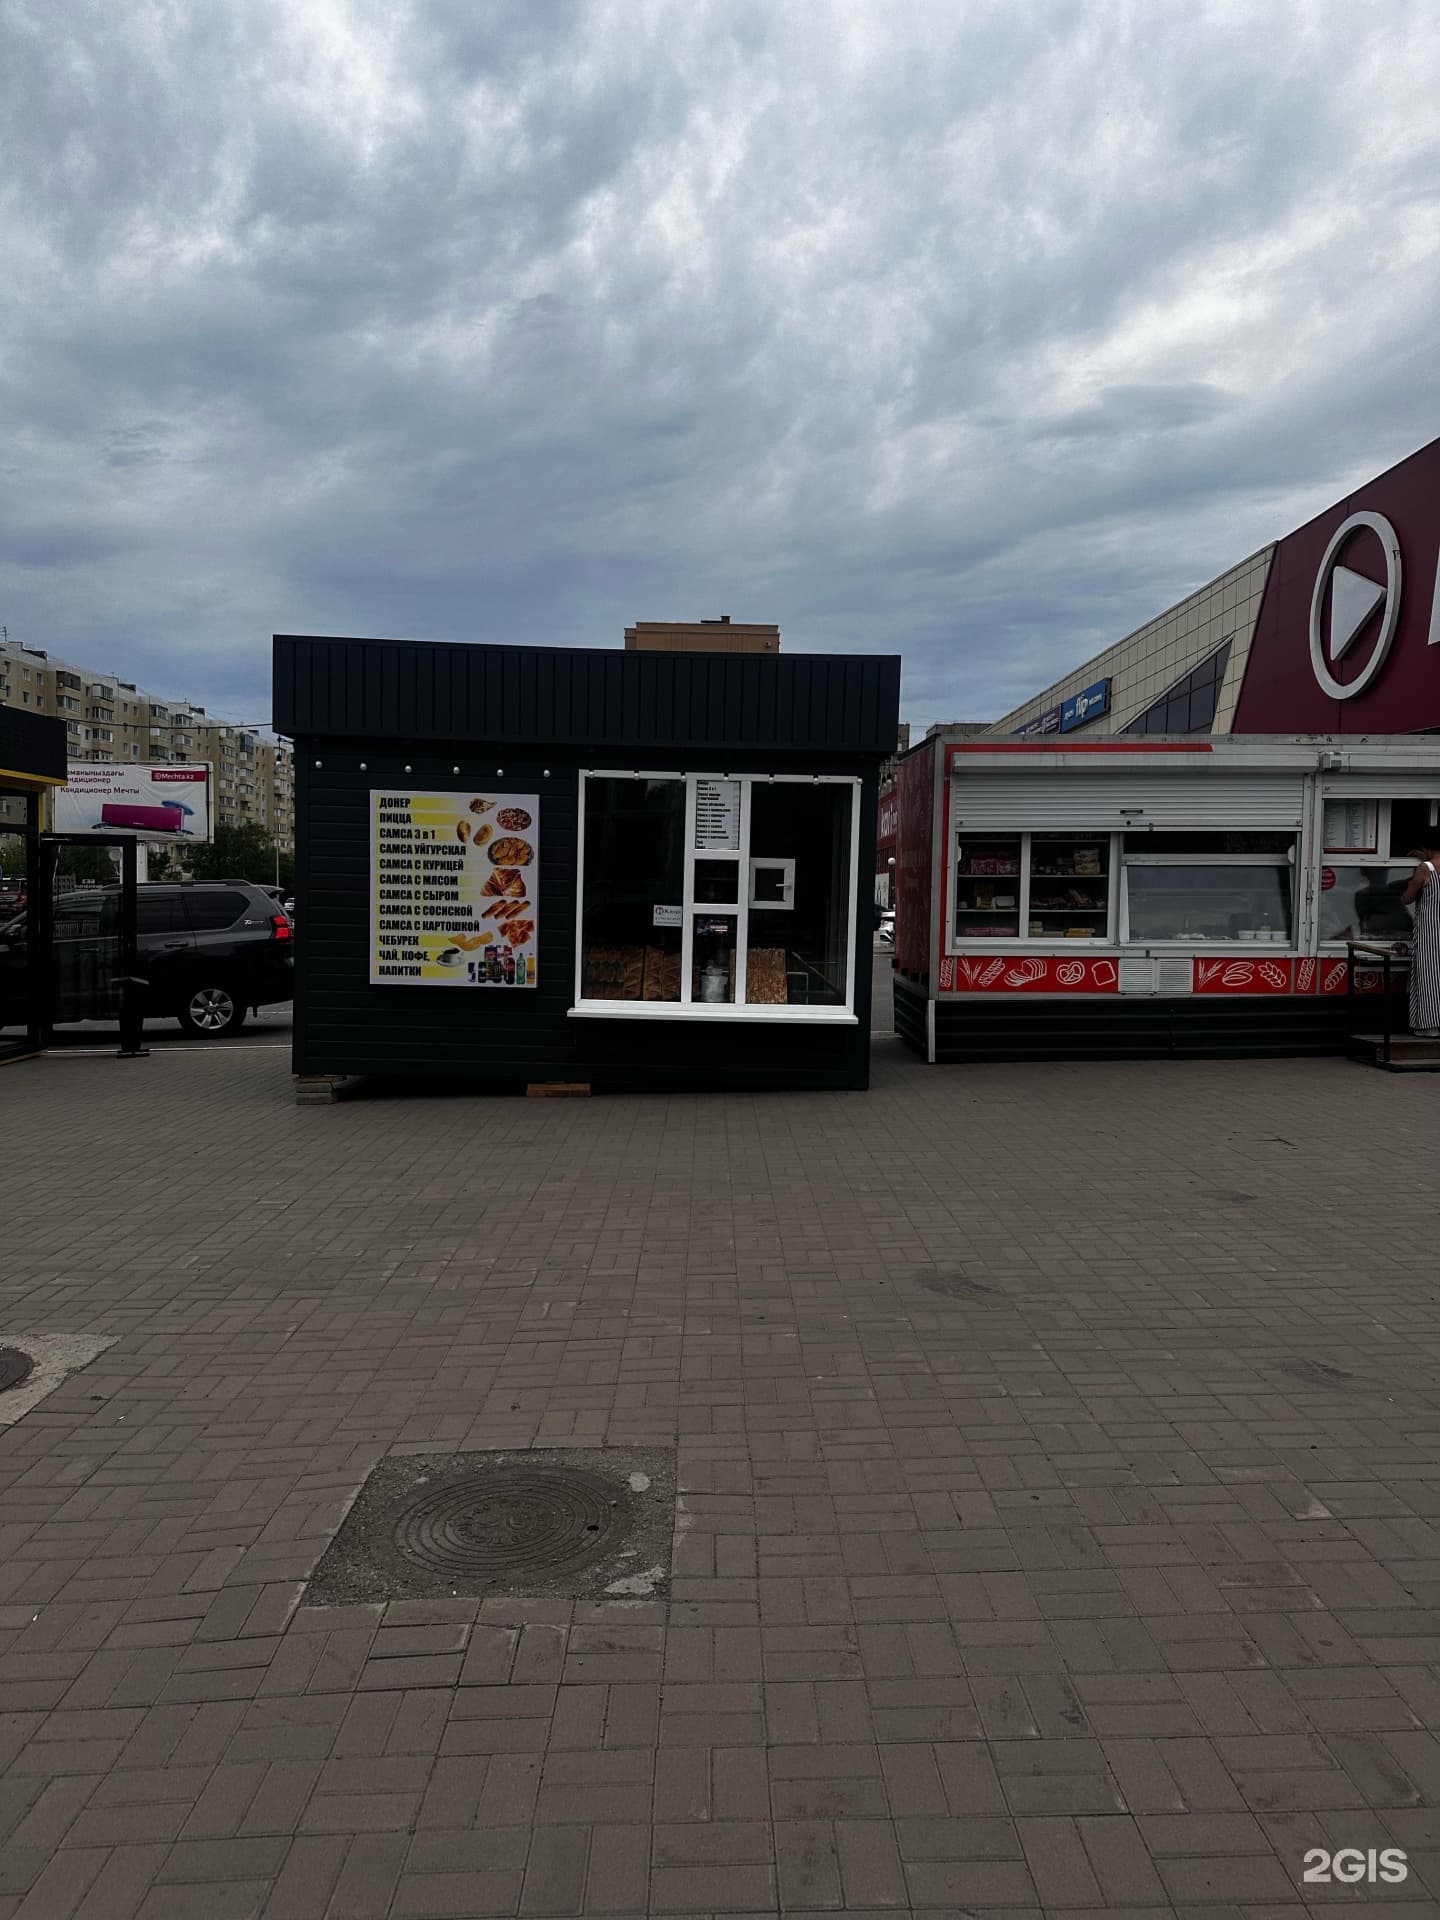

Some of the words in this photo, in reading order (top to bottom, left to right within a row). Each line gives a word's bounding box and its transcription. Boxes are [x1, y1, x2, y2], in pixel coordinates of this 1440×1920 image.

[60, 786, 112, 794] Кондиционер
[380, 797, 410, 809] ДОНЕР
[380, 813, 411, 824] ПИЦЦА
[380, 829, 412, 839] САМСА
[415, 830, 420, 839] 3
[431, 830, 435, 839] 1
[380, 844, 412, 854] САМСА
[415, 843, 466, 855] УЙГУРСКАЯ
[380, 859, 412, 869] САМСА
[415, 860, 421, 870] С
[423, 859, 463, 872] КУРИЦЕЙ
[380, 875, 412, 885] САМСА
[415, 875, 421, 885] С
[423, 875, 458, 886] МЯСОМ
[380, 890, 412, 900] САМСА
[415, 891, 421, 900] С
[423, 891, 459, 901] СЫРОМ
[380, 905, 412, 915] САМСА
[415, 906, 421, 916] С
[423, 905, 472, 916] СОСИСКОЙ
[380, 920, 412, 930] САМСА
[415, 921, 421, 931] С
[423, 920, 479, 931] КАРТОШКОЙ
[379, 935, 419, 946] ЧЕБУРЕК
[379, 950, 400, 962] ЧАЙ,
[402, 951, 430, 962] КОФЕ,
[379, 966, 421, 976] НАПИТКИ
